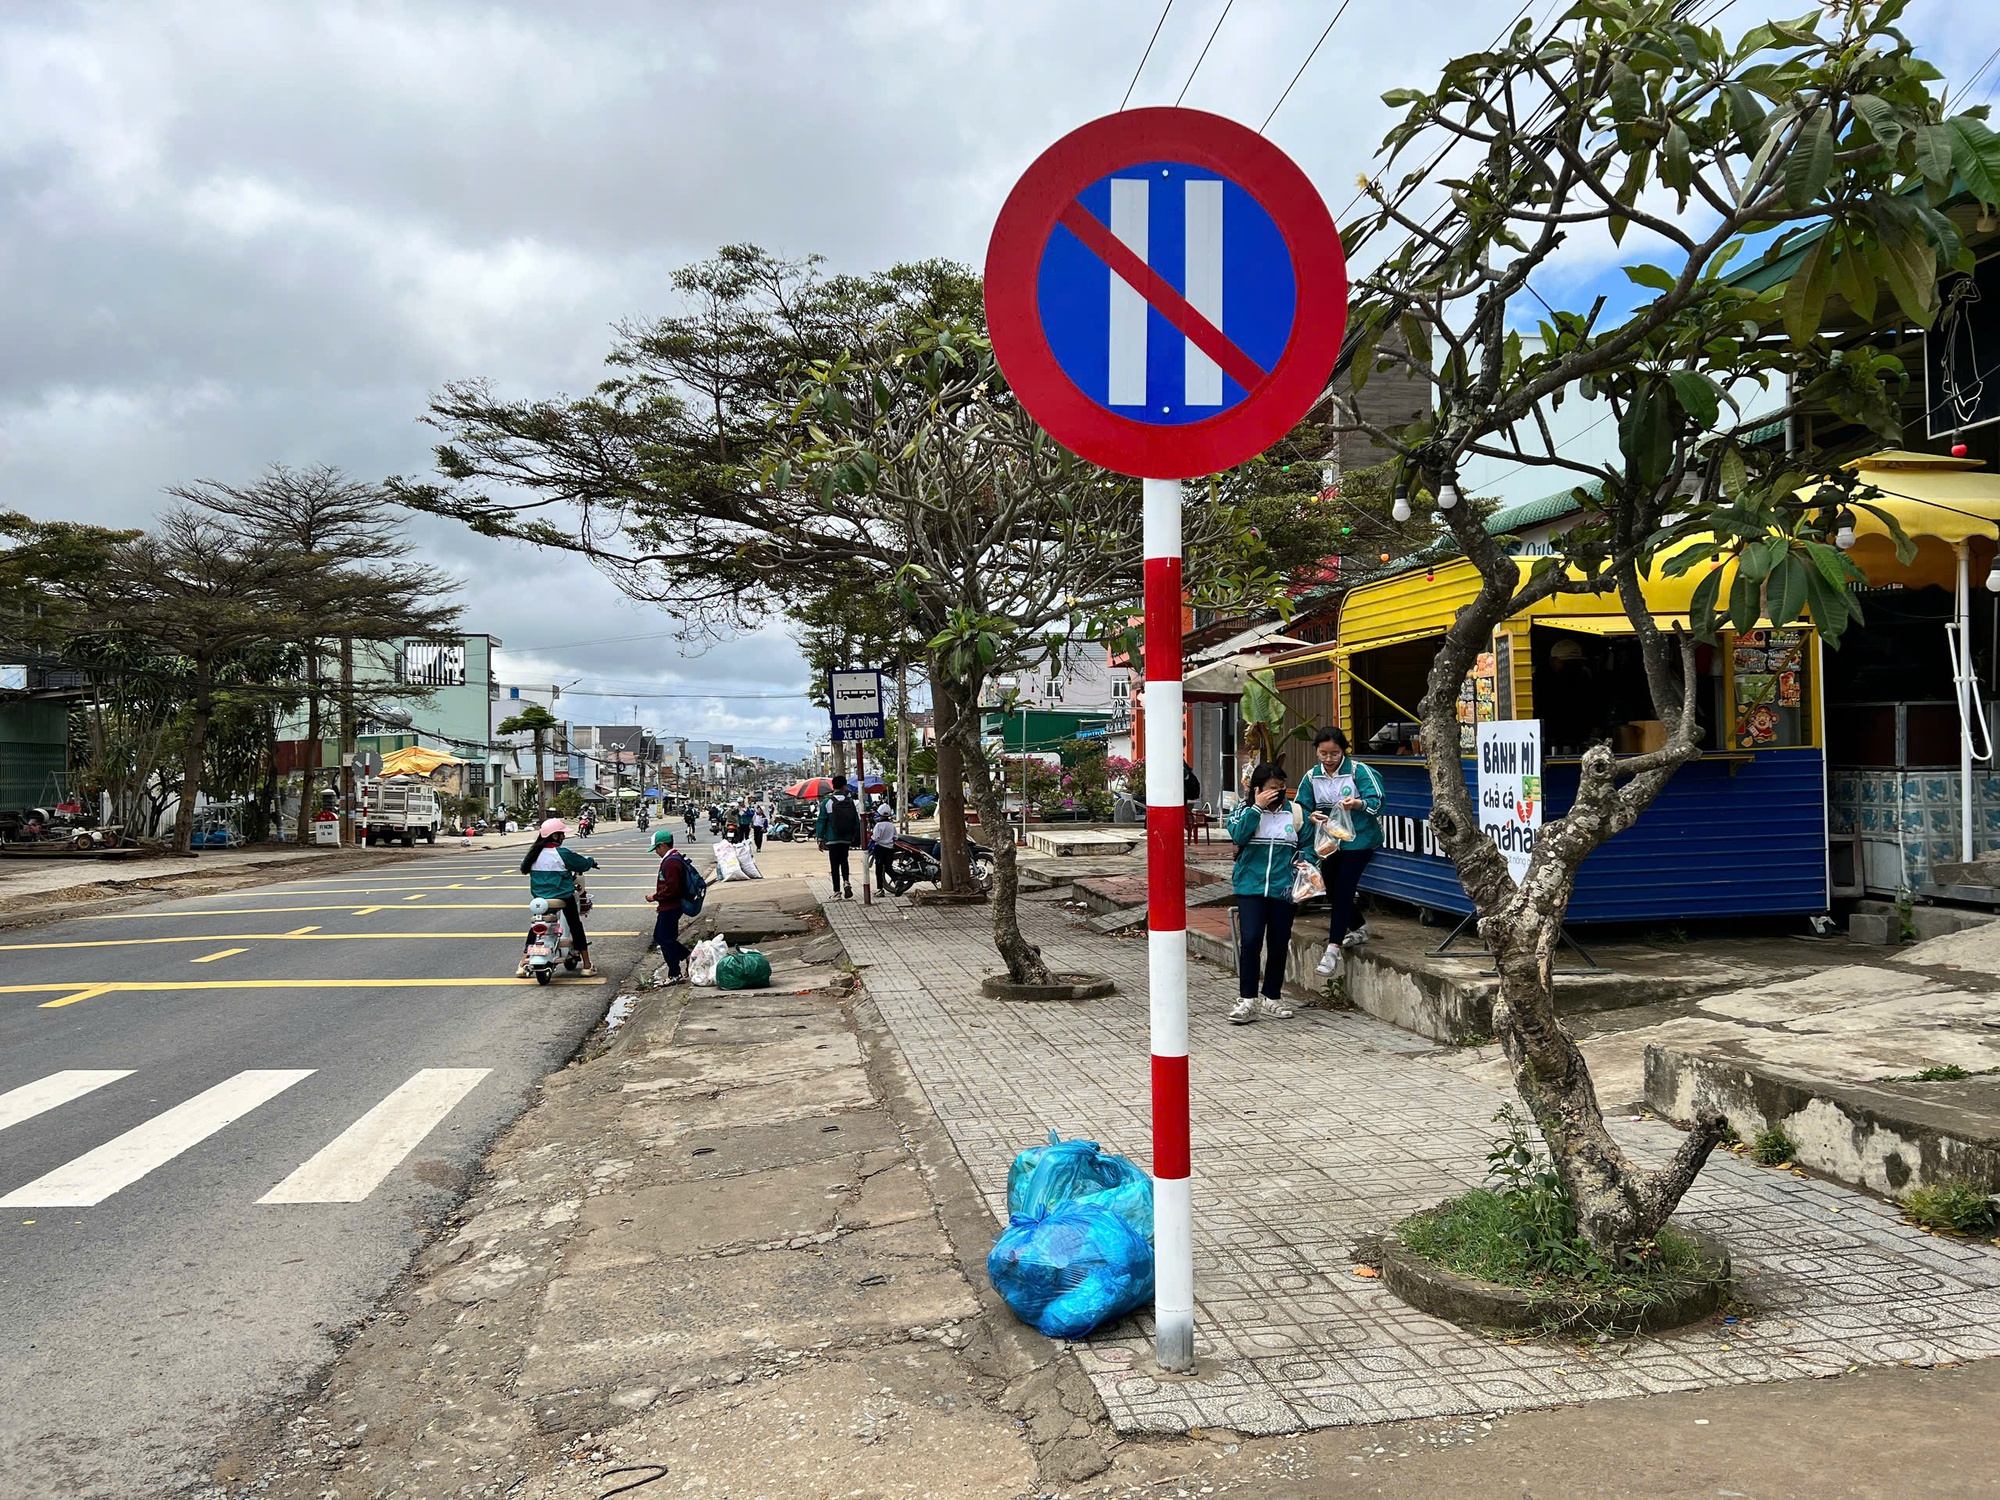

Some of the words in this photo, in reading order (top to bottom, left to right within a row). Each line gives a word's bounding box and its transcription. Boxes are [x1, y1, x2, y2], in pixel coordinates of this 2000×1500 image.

[837, 715, 857, 729] ĐIỂM
[858, 715, 879, 728] DỪNG
[843, 730, 853, 739] XE
[854, 727, 874, 739] BUÝT
[1483, 733, 1516, 774] BÁNH
[1521, 732, 1535, 775] MÌ
[1483, 783, 1500, 808] chả
[1503, 786, 1514, 810] cá
